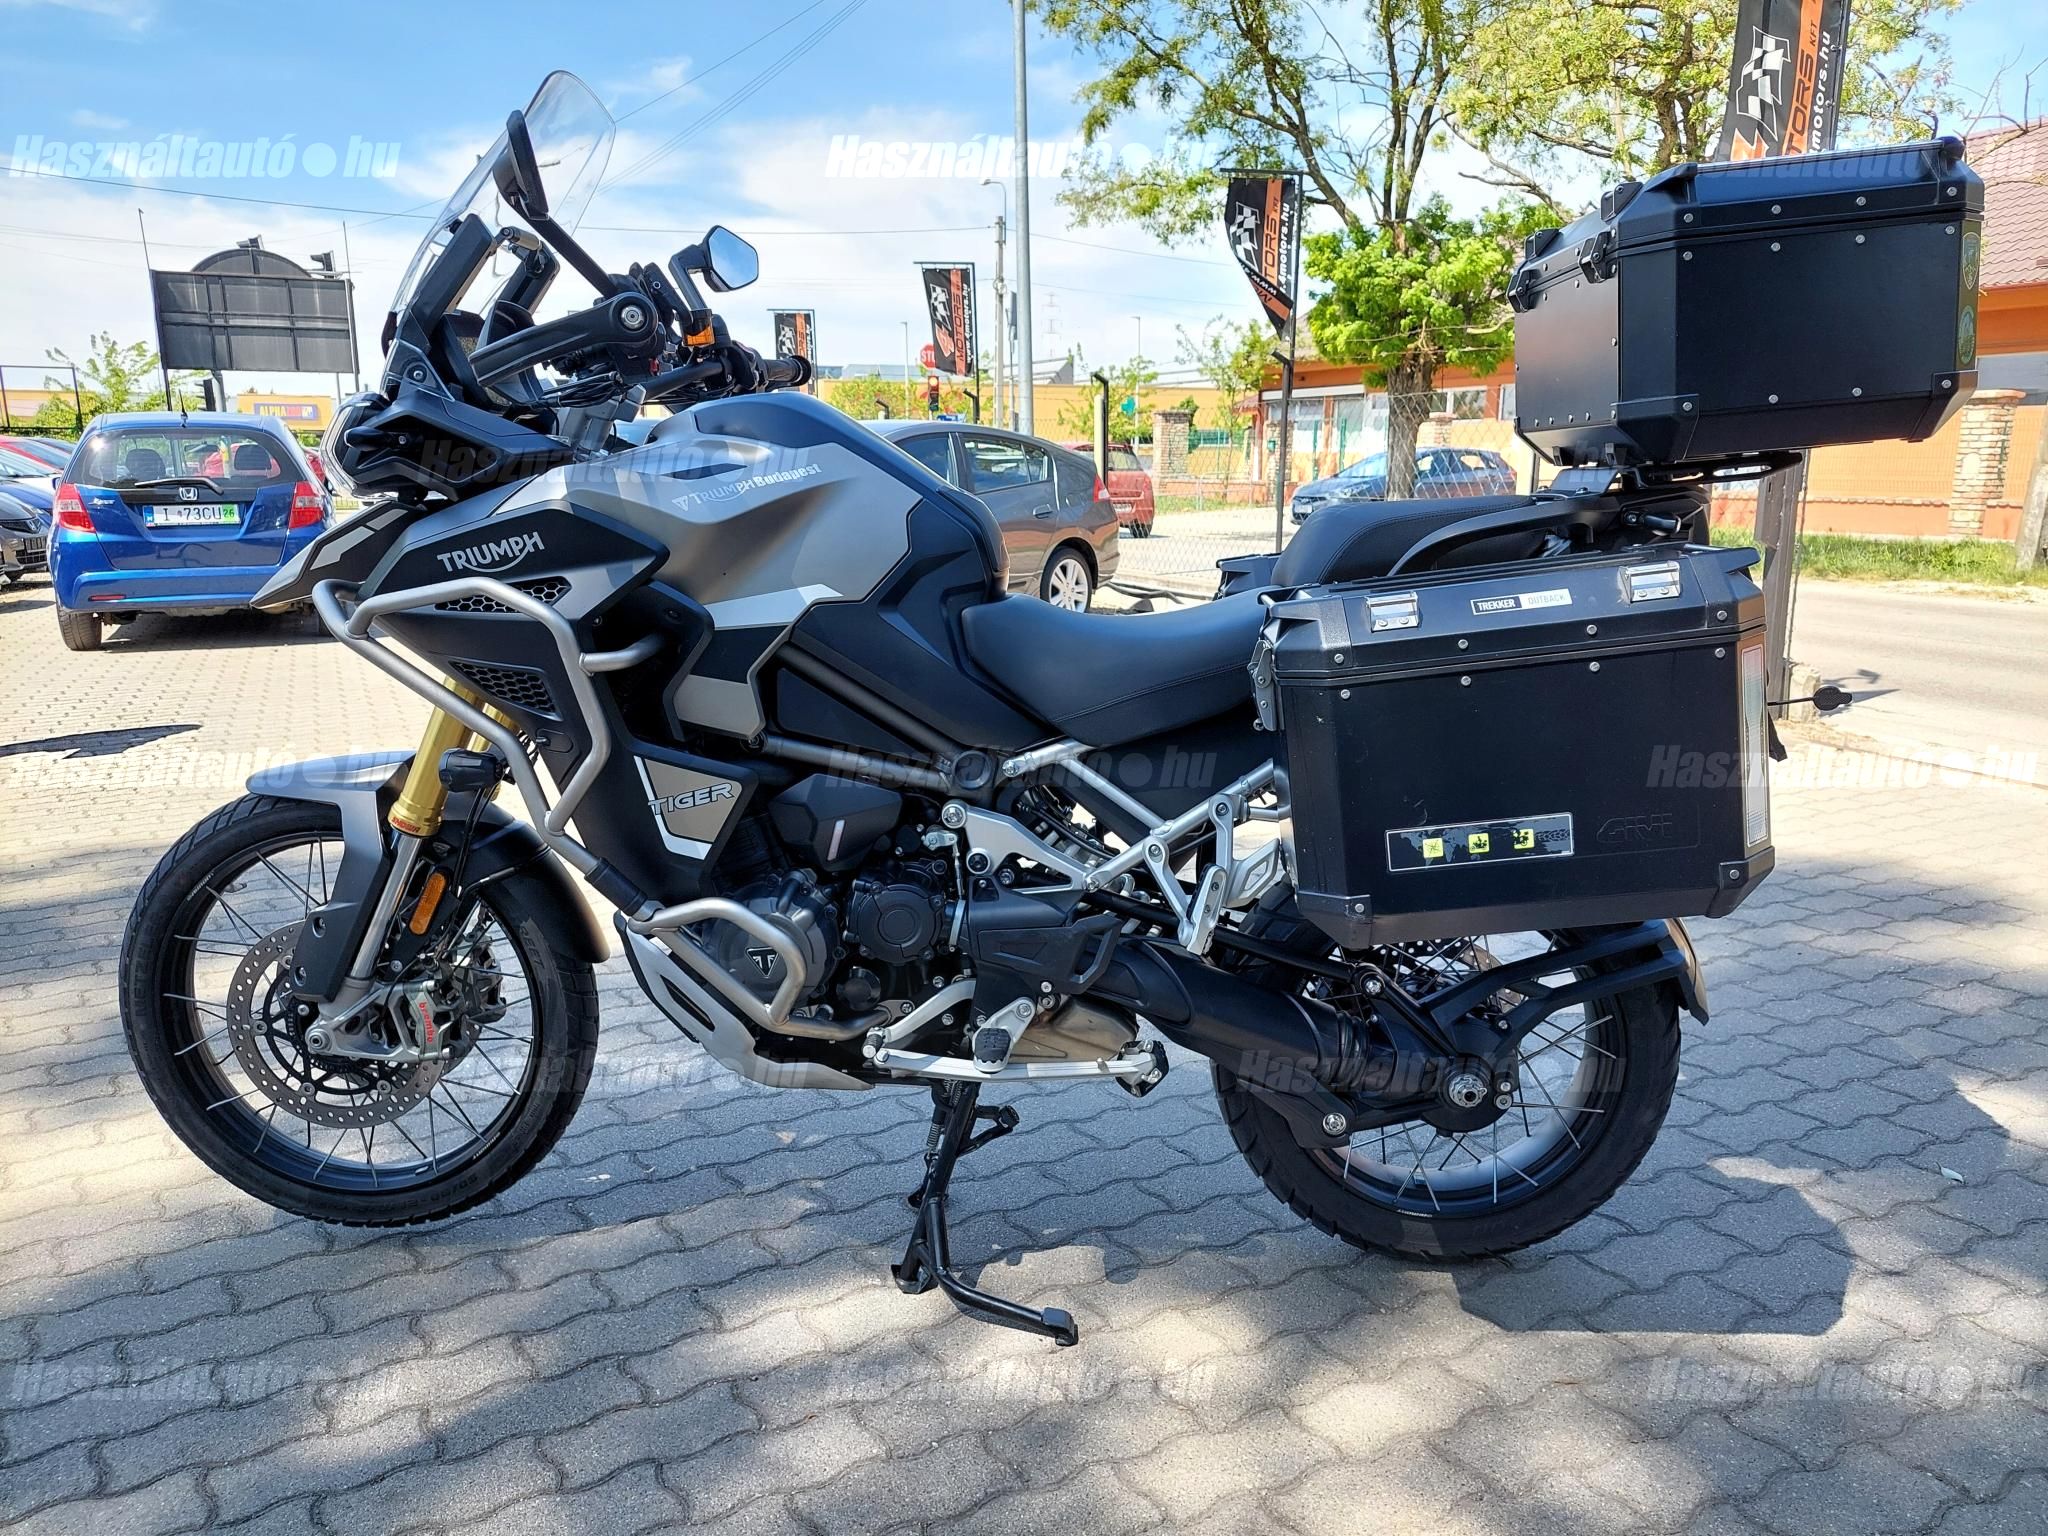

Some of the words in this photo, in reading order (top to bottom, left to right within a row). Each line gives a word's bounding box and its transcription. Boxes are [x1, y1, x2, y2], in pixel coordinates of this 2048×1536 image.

[1785, 49, 1814, 154] TORS
[1809, 19, 1818, 47] KFT
[1808, 31, 1831, 152] motors.hu
[1264, 214, 1277, 279] TORS
[921, 350, 935, 363] ST
[688, 479, 756, 504] TRIUMPH
[752, 463, 823, 487] Budapest
[436, 531, 545, 573] TRIUMPH
[1477, 598, 1516, 611] TREKKER
[1528, 594, 1564, 605] OUTBACK
[647, 782, 735, 816] TIGER
[418, 1001, 435, 1043] brembo
